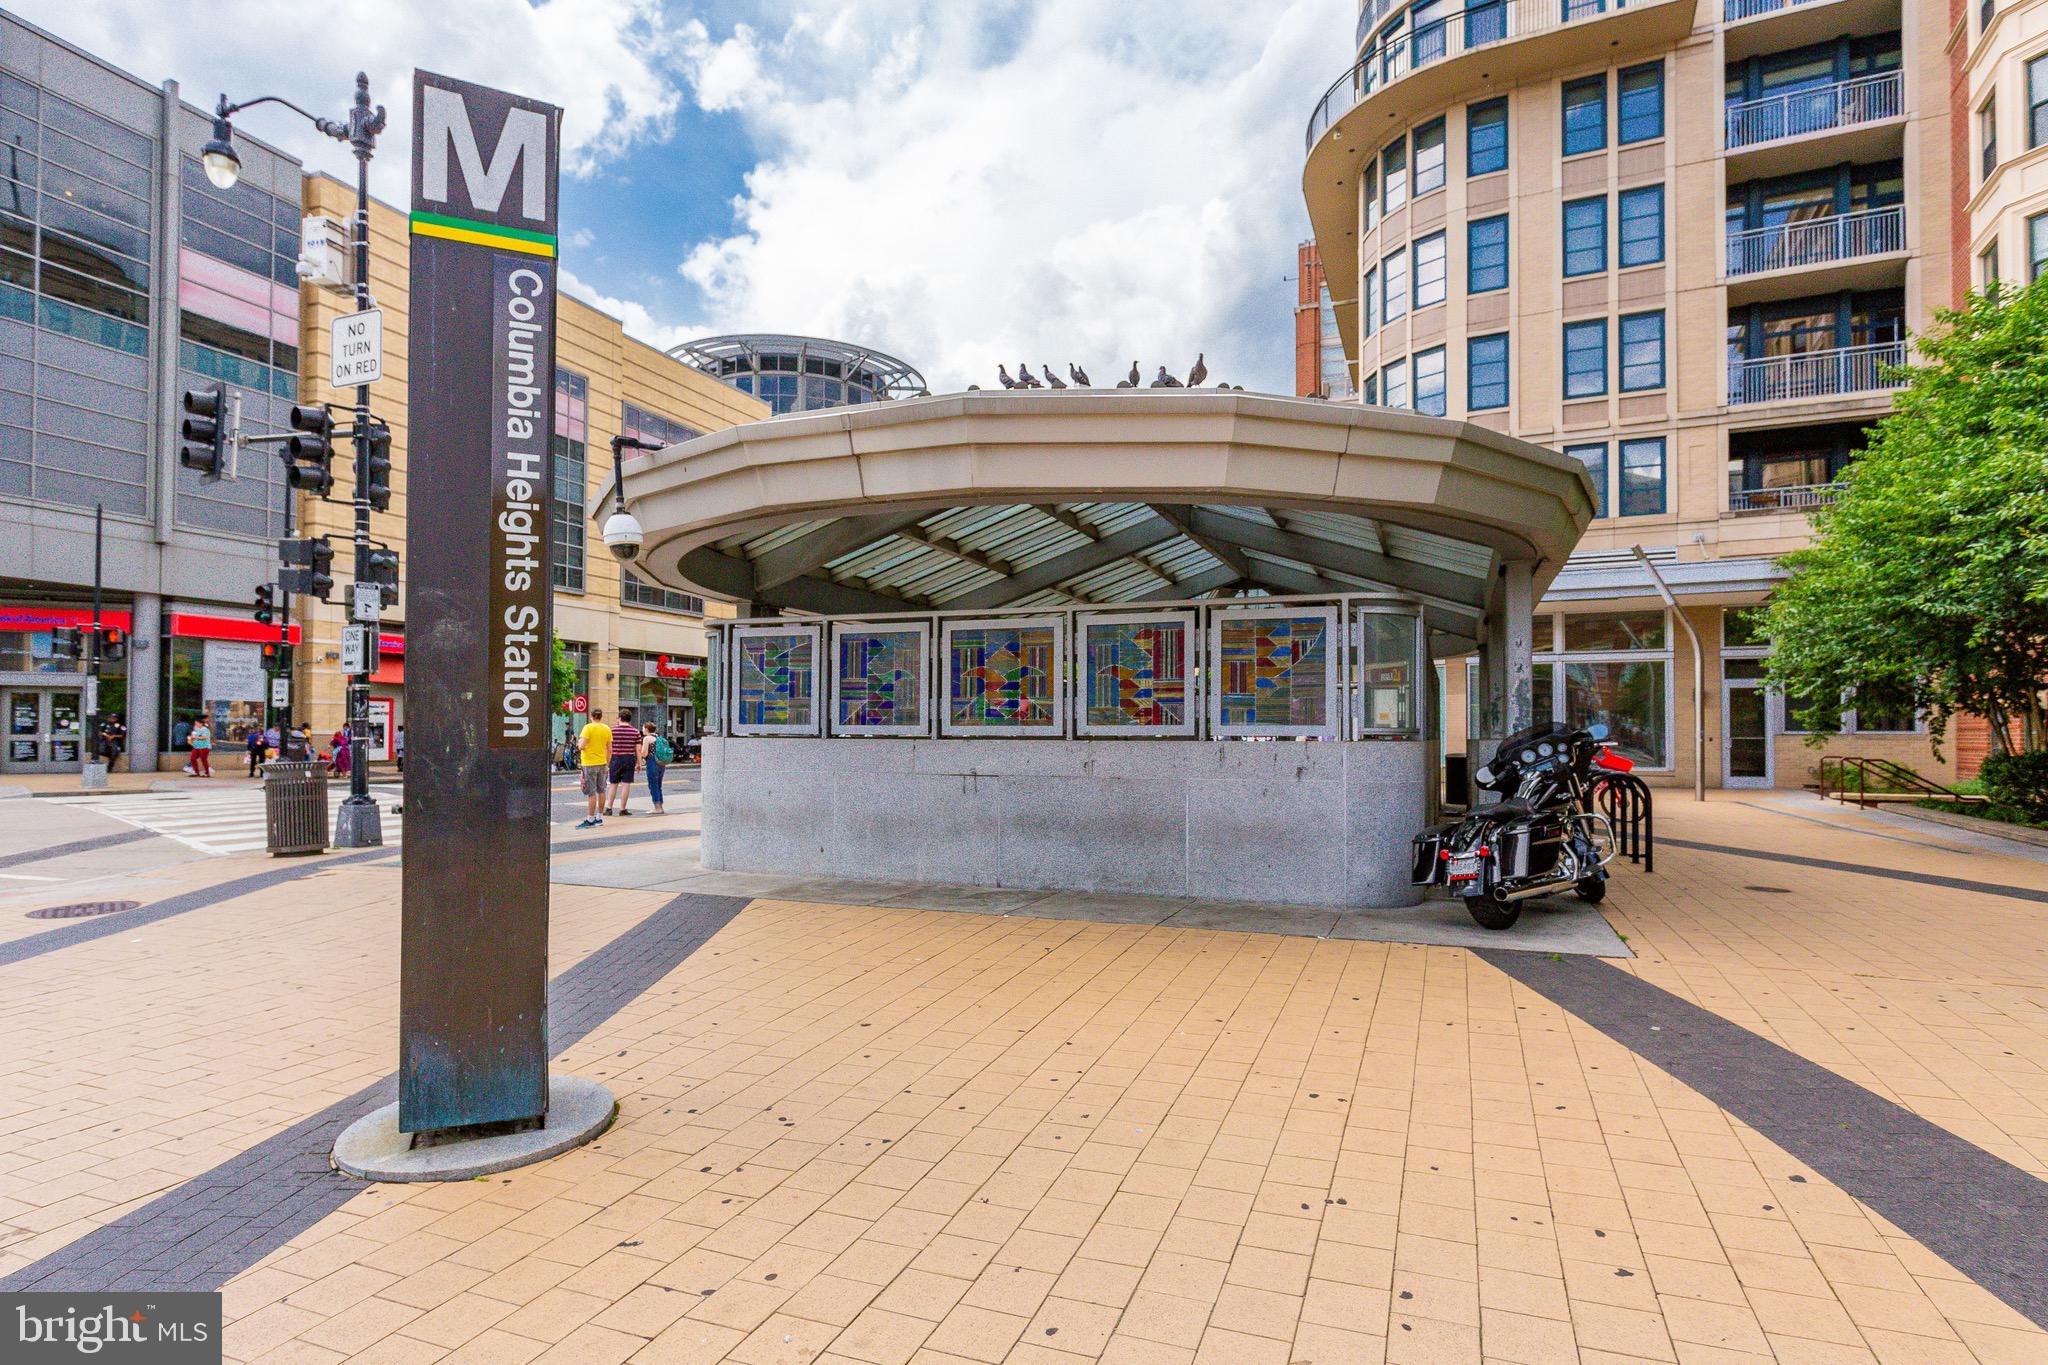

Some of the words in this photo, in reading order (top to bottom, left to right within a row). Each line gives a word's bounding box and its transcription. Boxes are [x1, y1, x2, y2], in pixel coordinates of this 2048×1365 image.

[423, 84, 547, 222] M
[348, 322, 366, 337] NO
[343, 340, 371, 358] TURN
[506, 268, 544, 440] Columbia
[336, 364, 351, 378] ON
[356, 358, 377, 375] RED
[498, 451, 541, 592] Heights
[344, 629, 360, 642] ONE
[344, 643, 360, 656] WAY
[502, 604, 540, 738] Station
